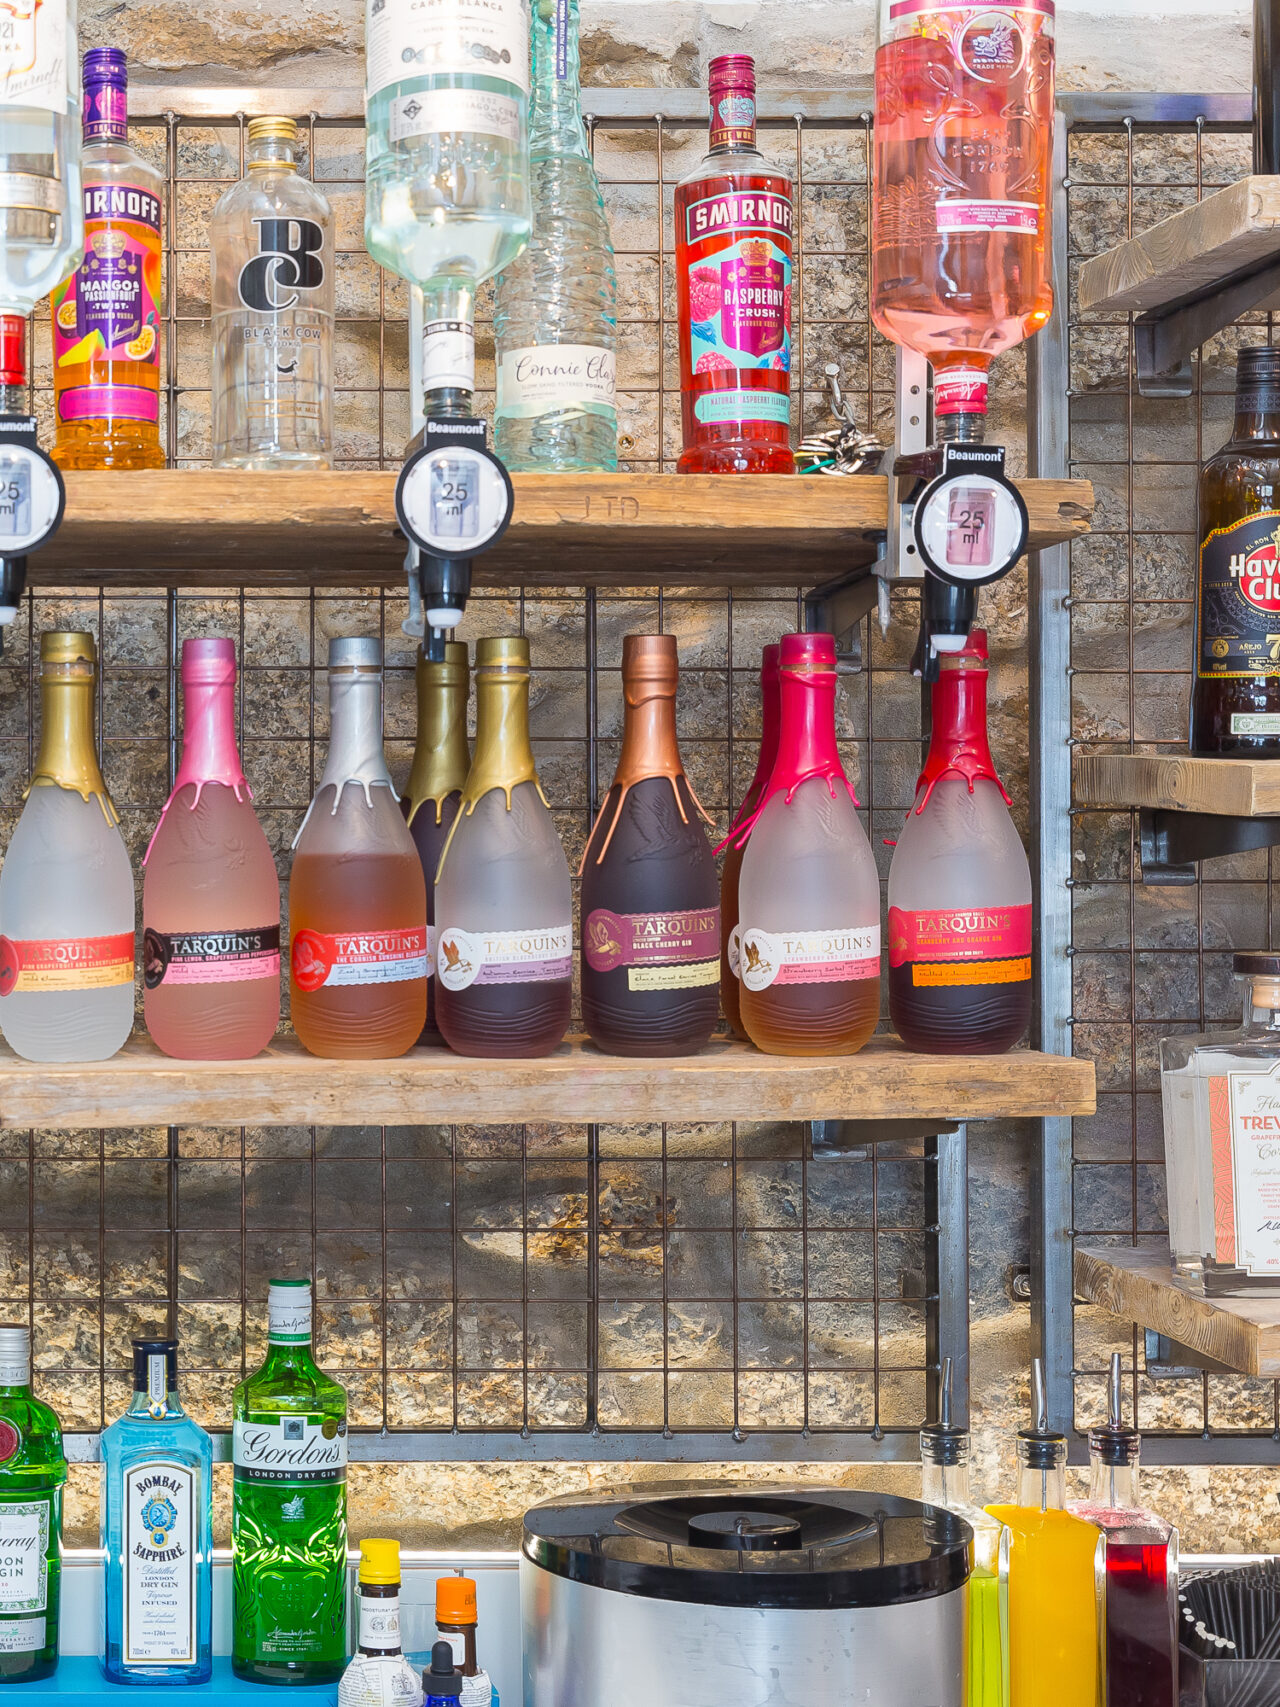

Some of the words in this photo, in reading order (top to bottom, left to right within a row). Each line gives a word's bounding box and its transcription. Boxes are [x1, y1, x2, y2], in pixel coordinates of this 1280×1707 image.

[85, 190, 158, 222] IRNOFF
[80, 280, 132, 292] MANGO
[85, 291, 135, 302] PASSIONFRUIT
[724, 288, 783, 306] RASPBERRY
[738, 309, 776, 317] CRUSH
[296, 328, 321, 339] COW
[516, 355, 582, 383] Connie
[428, 422, 484, 434] Beaumont
[948, 449, 1001, 462] Beaumont
[442, 483, 468, 501] 25
[0, 503, 16, 515] ml
[959, 510, 984, 529] 25
[963, 531, 979, 544] ml
[1245, 543, 1253, 551] EL
[1253, 536, 1270, 545] RON
[632, 916, 715, 936] TARQUIN'S
[916, 914, 1010, 933] TARQUIN'S
[23, 944, 112, 963] TARQUIN'S
[170, 935, 261, 955] TARQUIN'S
[335, 935, 419, 955] TARQUIN'S
[483, 935, 567, 954] TARQUIN'S
[783, 935, 871, 954] TARQUIN'S
[243, 1430, 339, 1465] Gordon's
[249, 1471, 291, 1479] LONDON
[297, 1471, 316, 1479] DRY
[321, 1470, 336, 1478] GIN
[136, 1475, 184, 1496] BOMBAY
[133, 1542, 186, 1562] SAPPHIRE
[0, 1567, 24, 1578] GIN
[141, 1565, 178, 1575] Distilled
